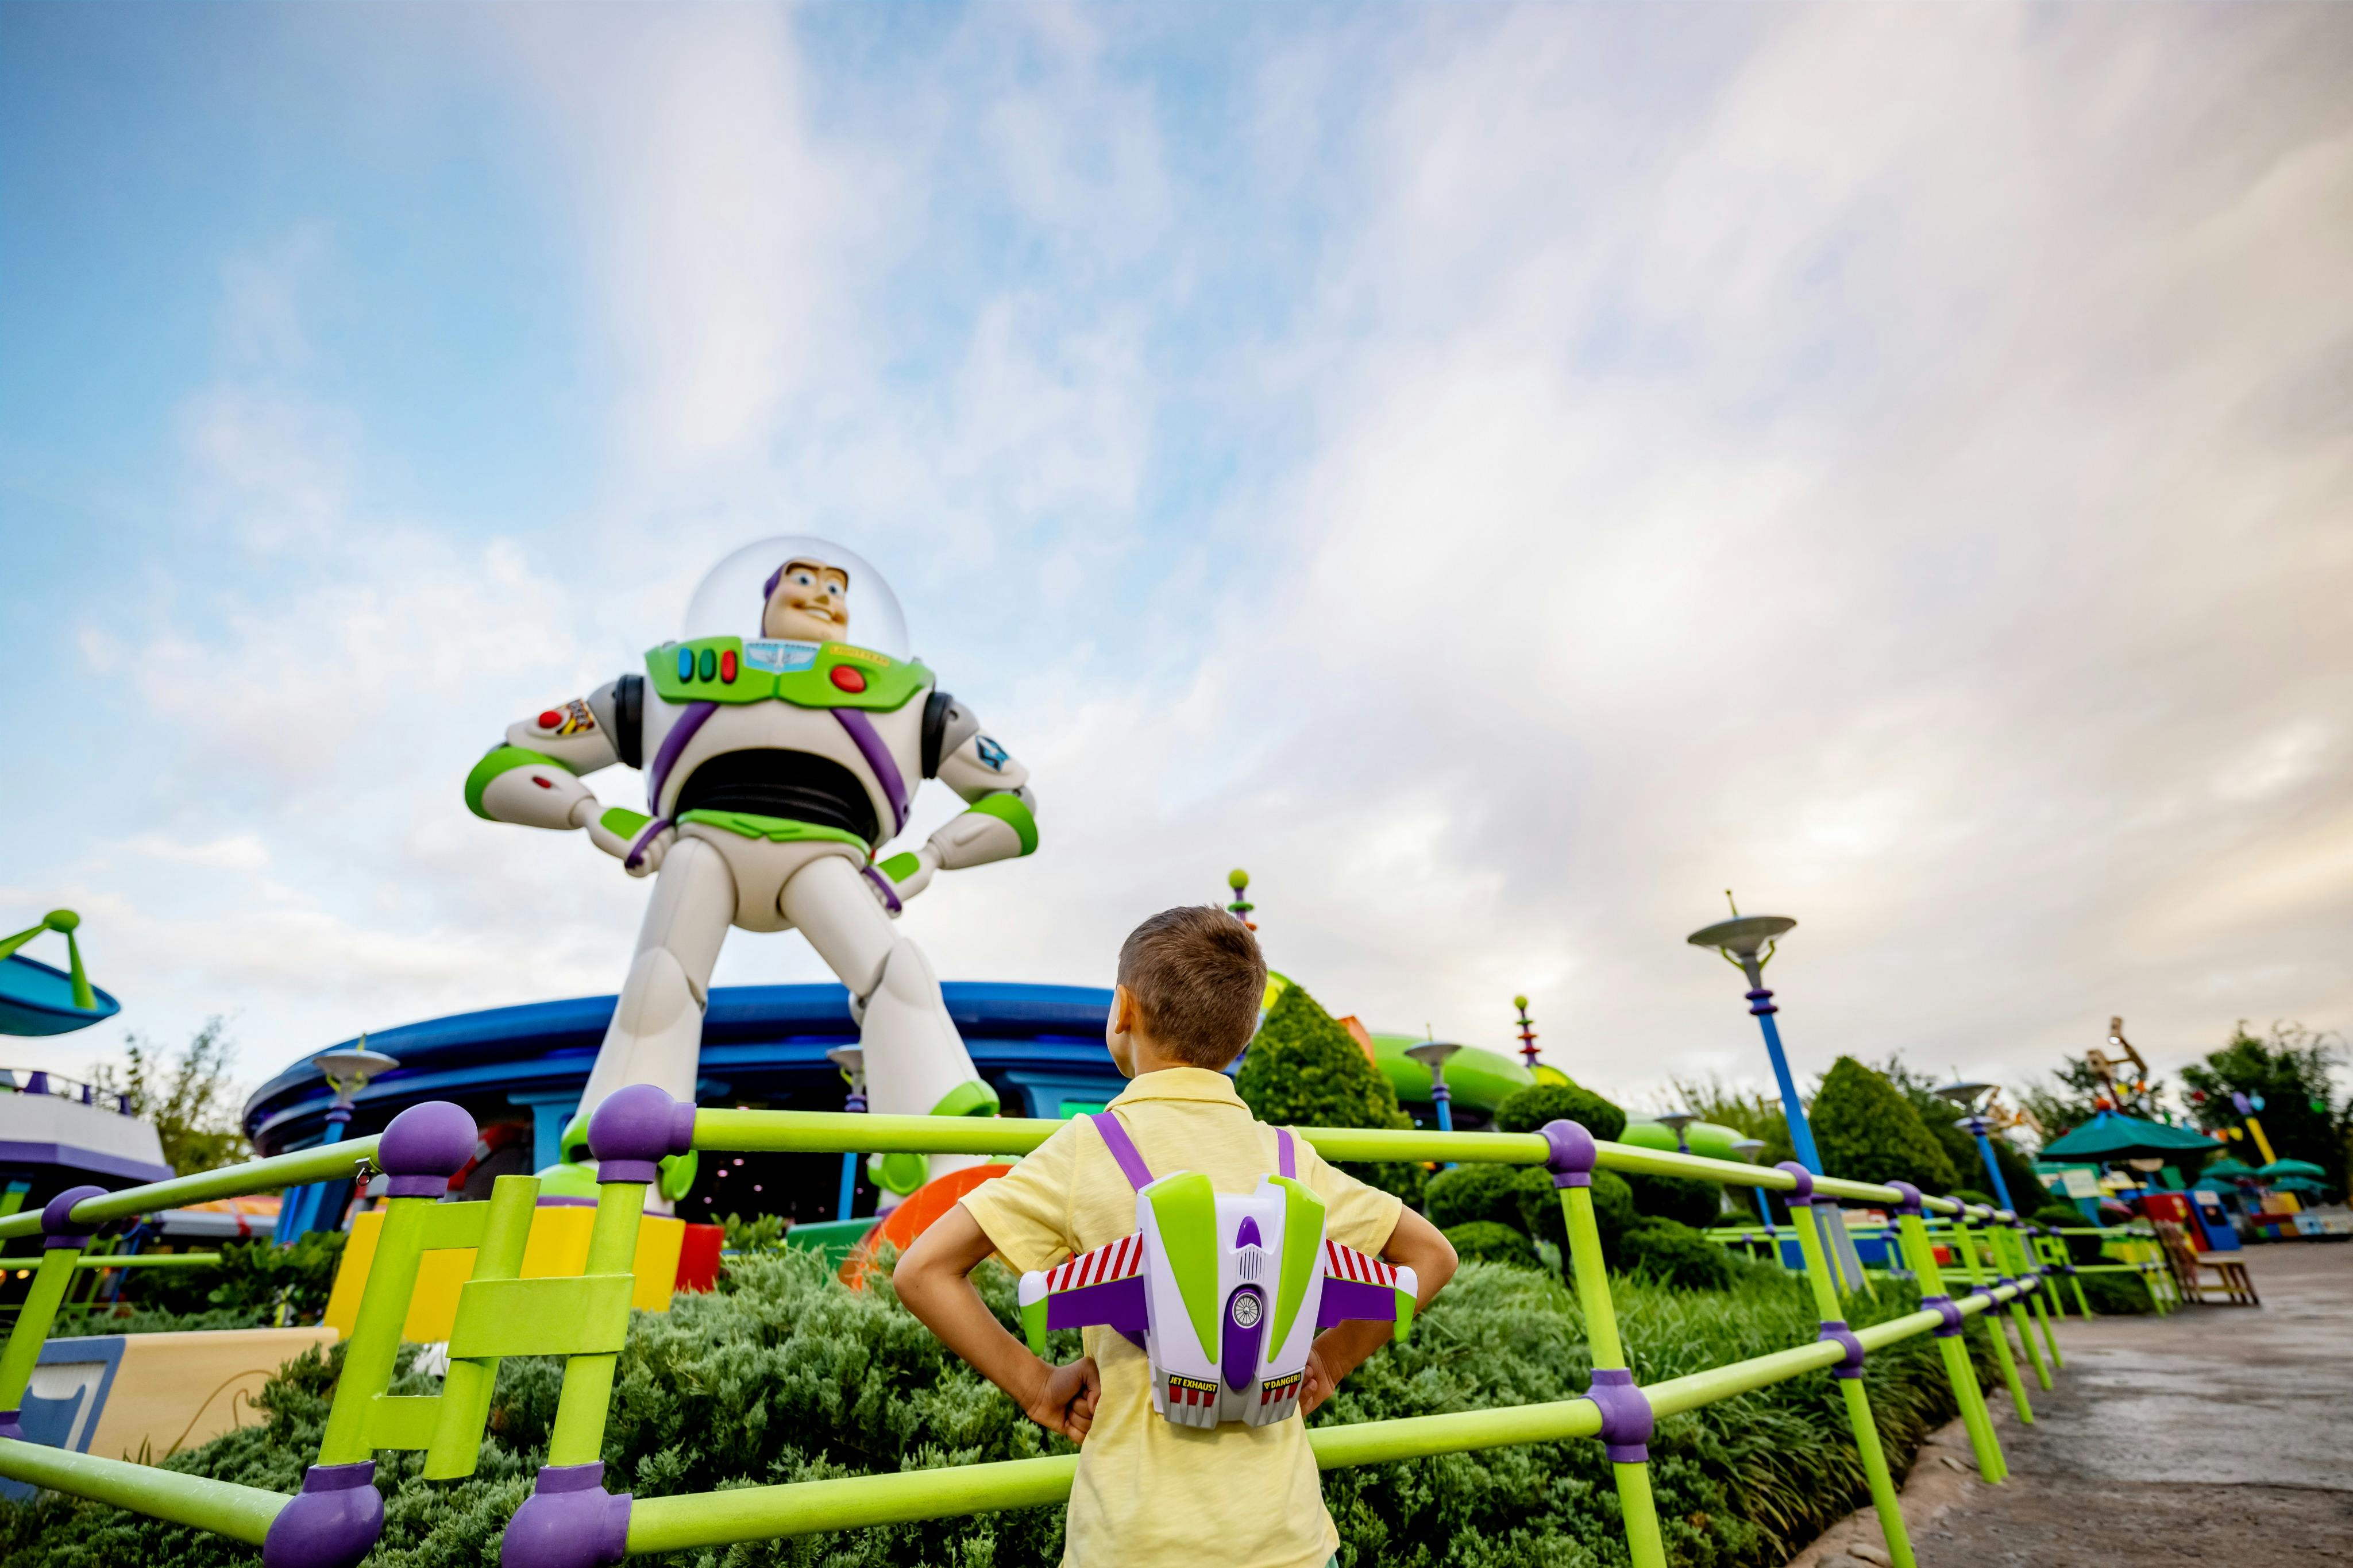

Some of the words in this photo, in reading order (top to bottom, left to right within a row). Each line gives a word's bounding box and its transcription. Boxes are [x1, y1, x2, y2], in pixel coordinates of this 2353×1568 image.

[1169, 1376, 1182, 1385] JET
[1183, 1378, 1217, 1392] EXHAUST
[1271, 1373, 1300, 1389] DANGER!
